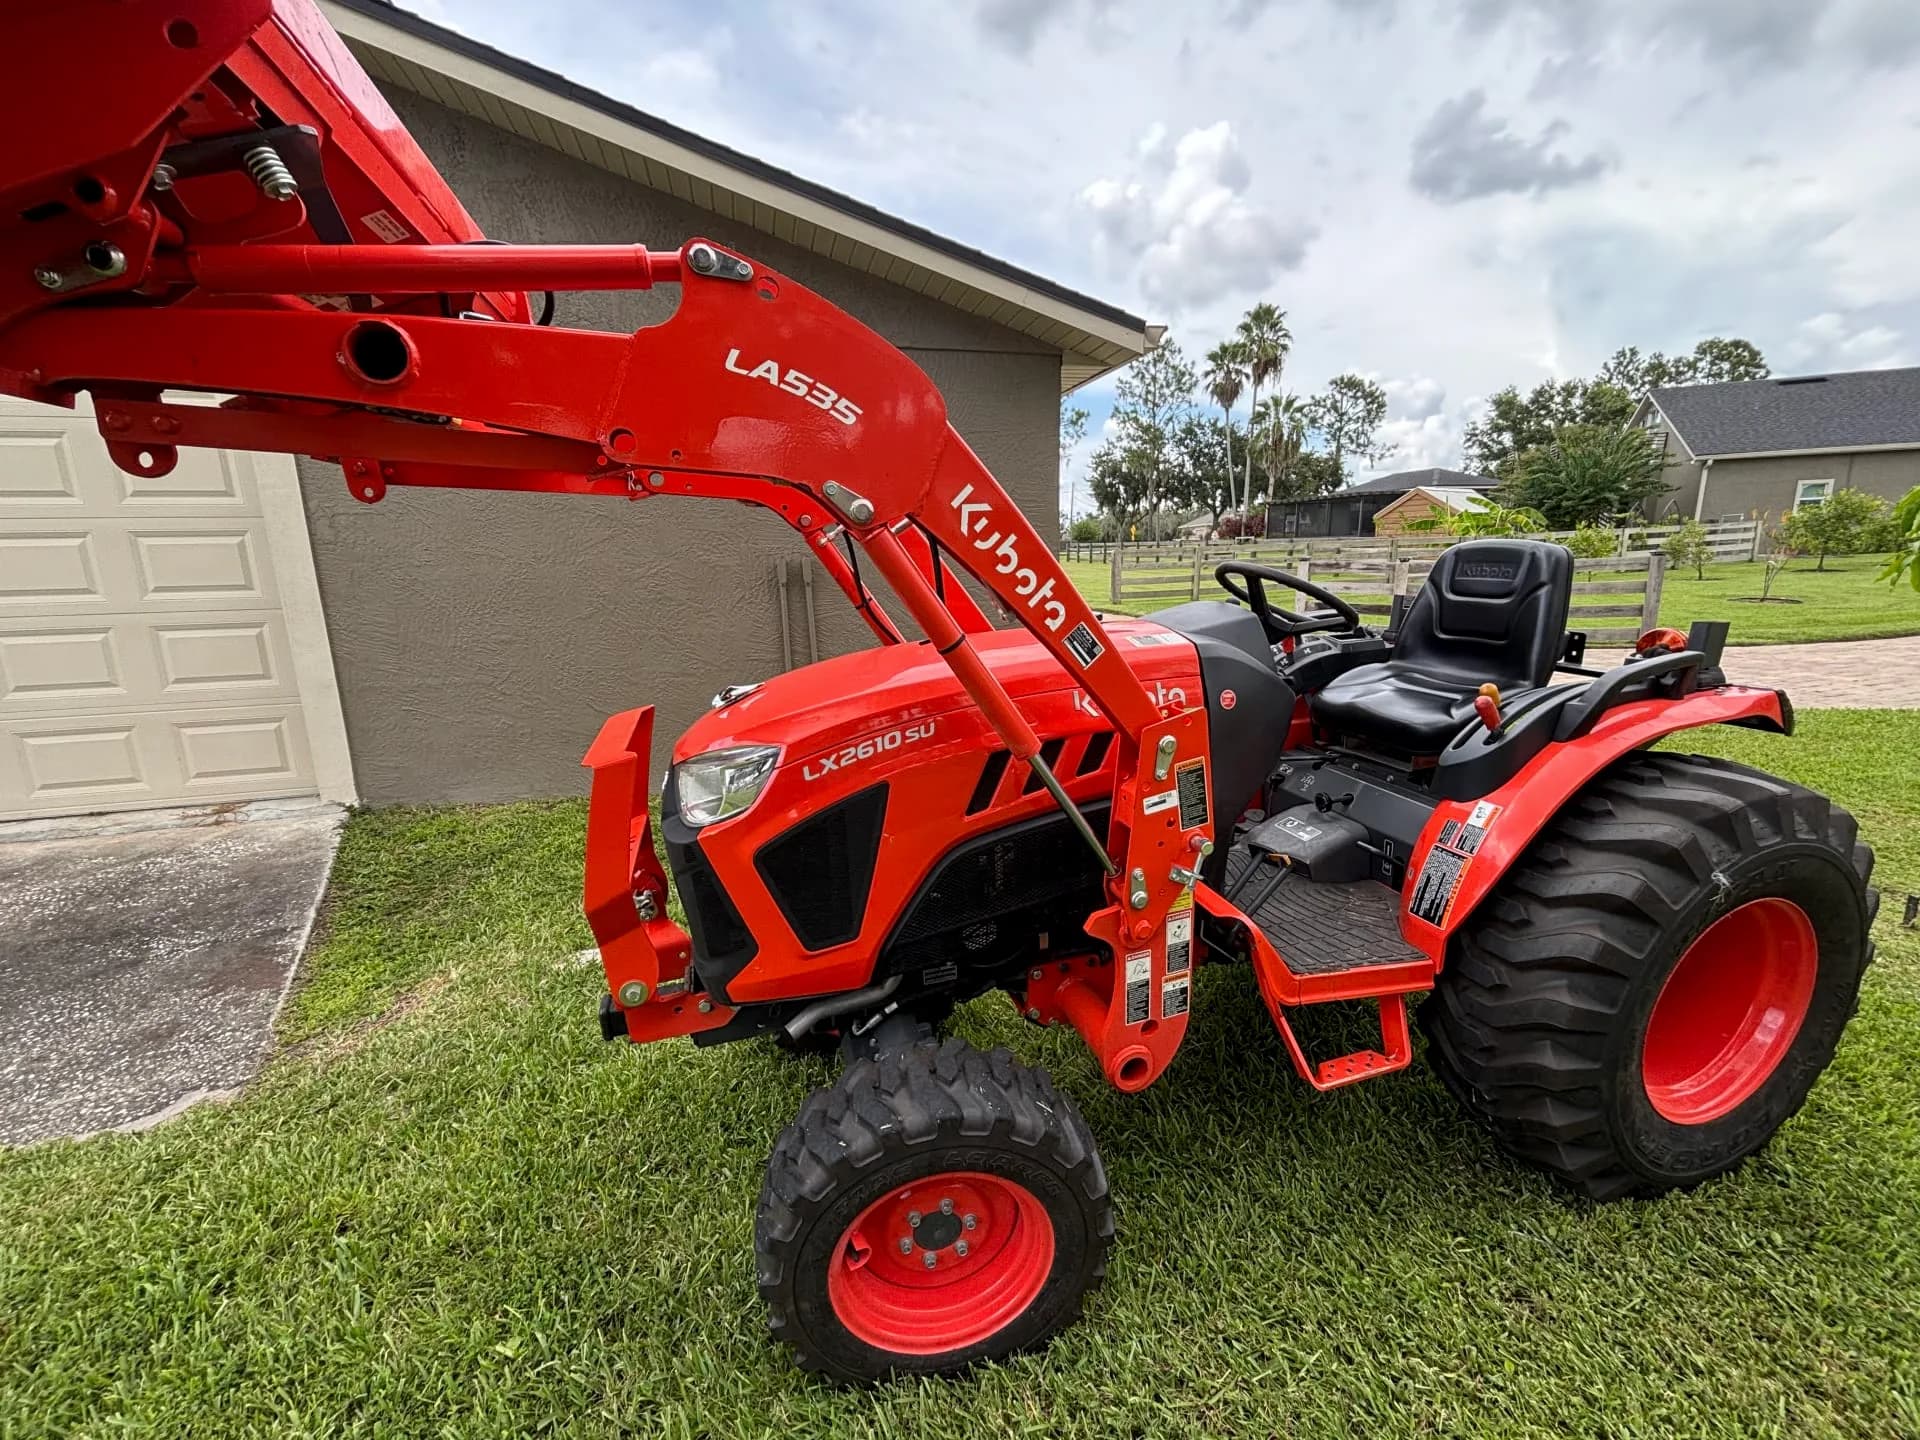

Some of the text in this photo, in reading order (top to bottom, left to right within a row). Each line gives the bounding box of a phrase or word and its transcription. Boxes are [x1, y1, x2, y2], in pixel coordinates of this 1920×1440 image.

[725, 348, 863, 425] LA535
[951, 483, 1066, 632] Kubota
[802, 721, 937, 782] LX2610 SU
